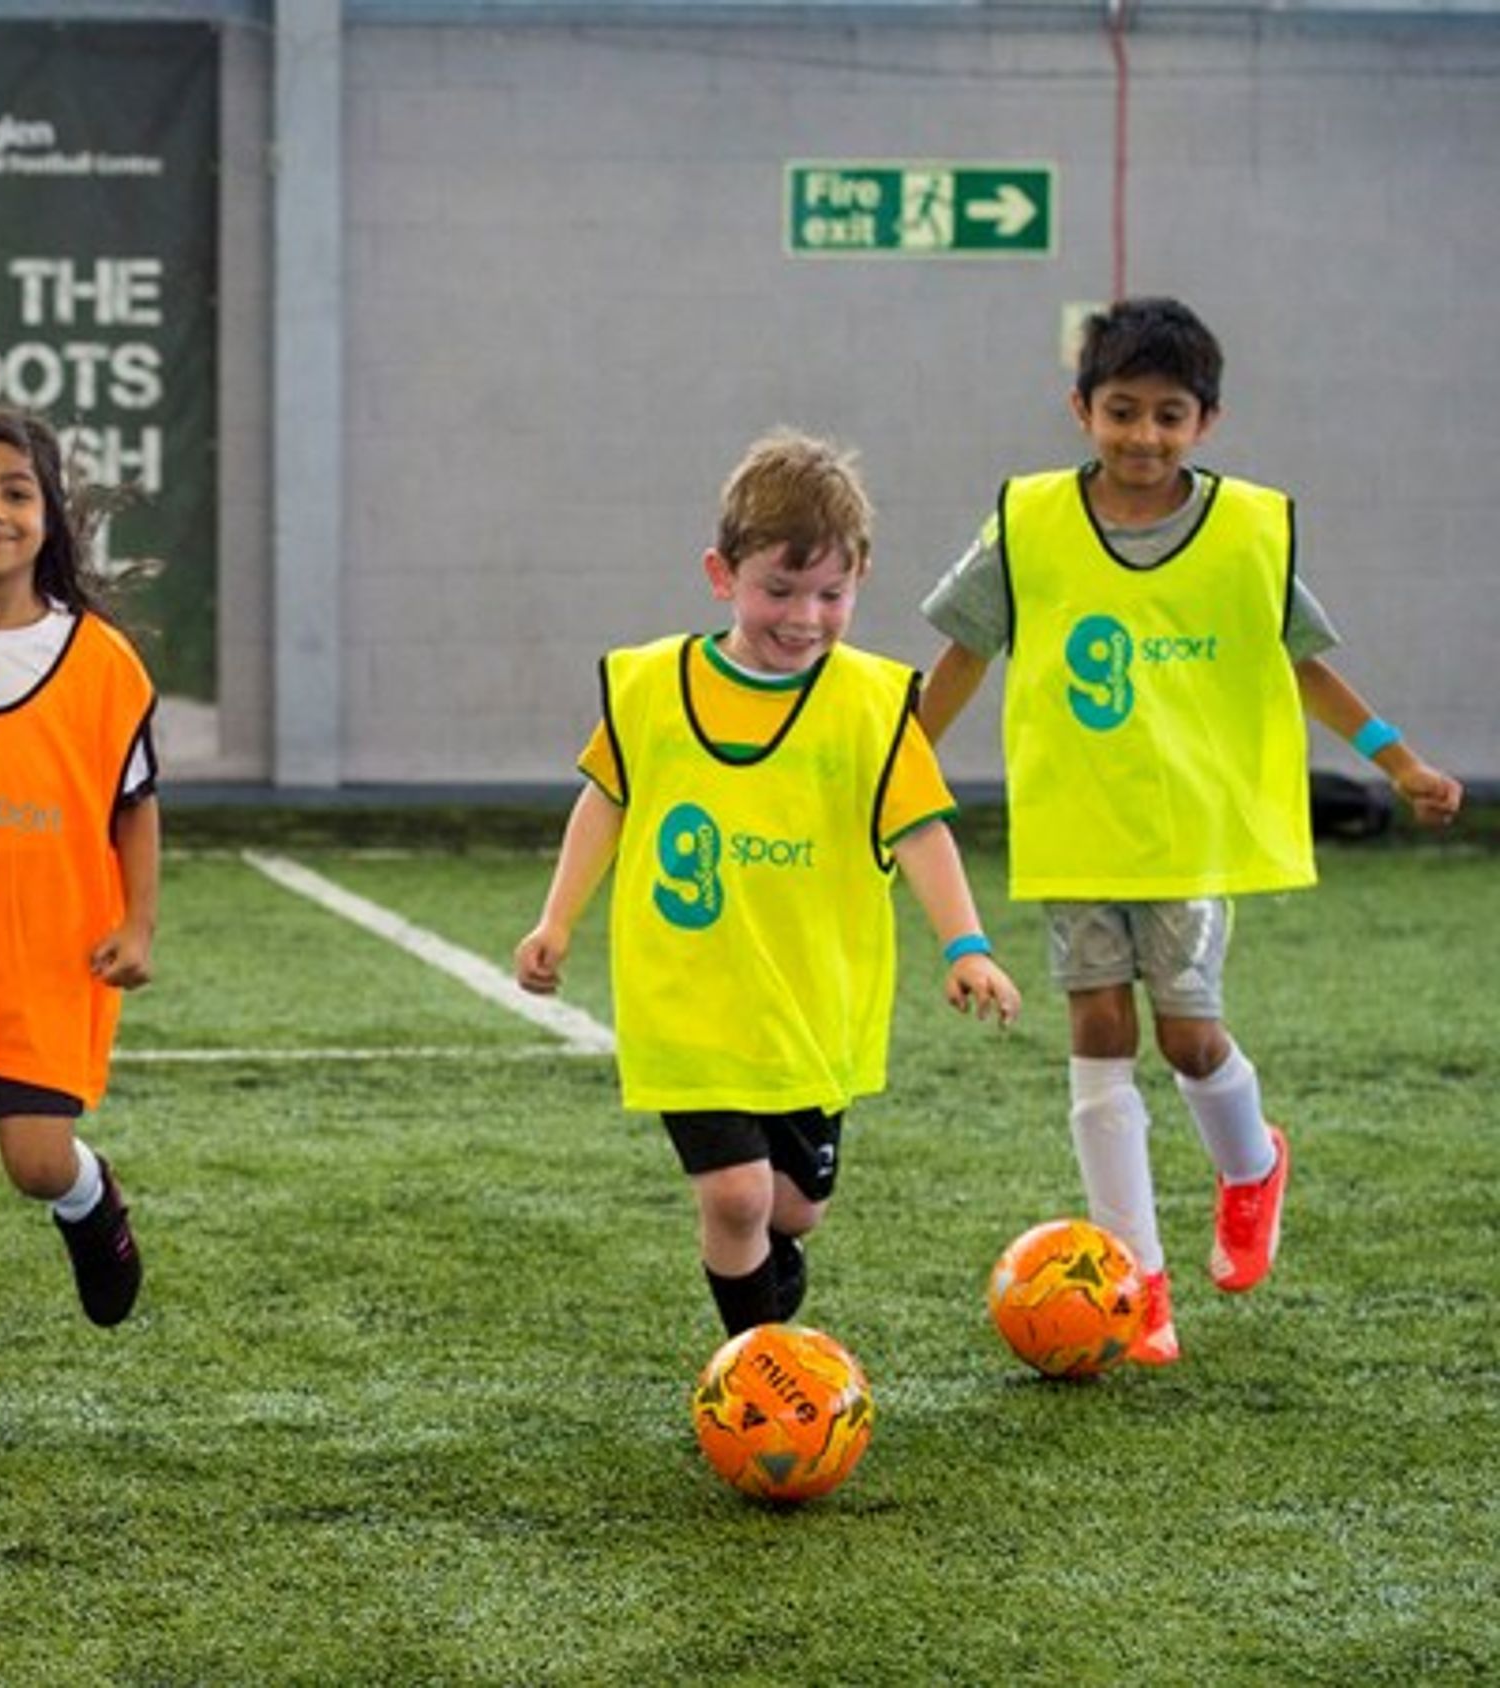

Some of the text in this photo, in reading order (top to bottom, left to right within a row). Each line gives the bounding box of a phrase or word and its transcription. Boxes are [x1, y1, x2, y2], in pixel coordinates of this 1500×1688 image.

[805, 171, 881, 207] Fire
[803, 212, 875, 246] exit
[8, 257, 162, 326] THE
[1140, 633, 1217, 668] sport
[729, 832, 816, 868] sport
[753, 1352, 819, 1425] mitre
